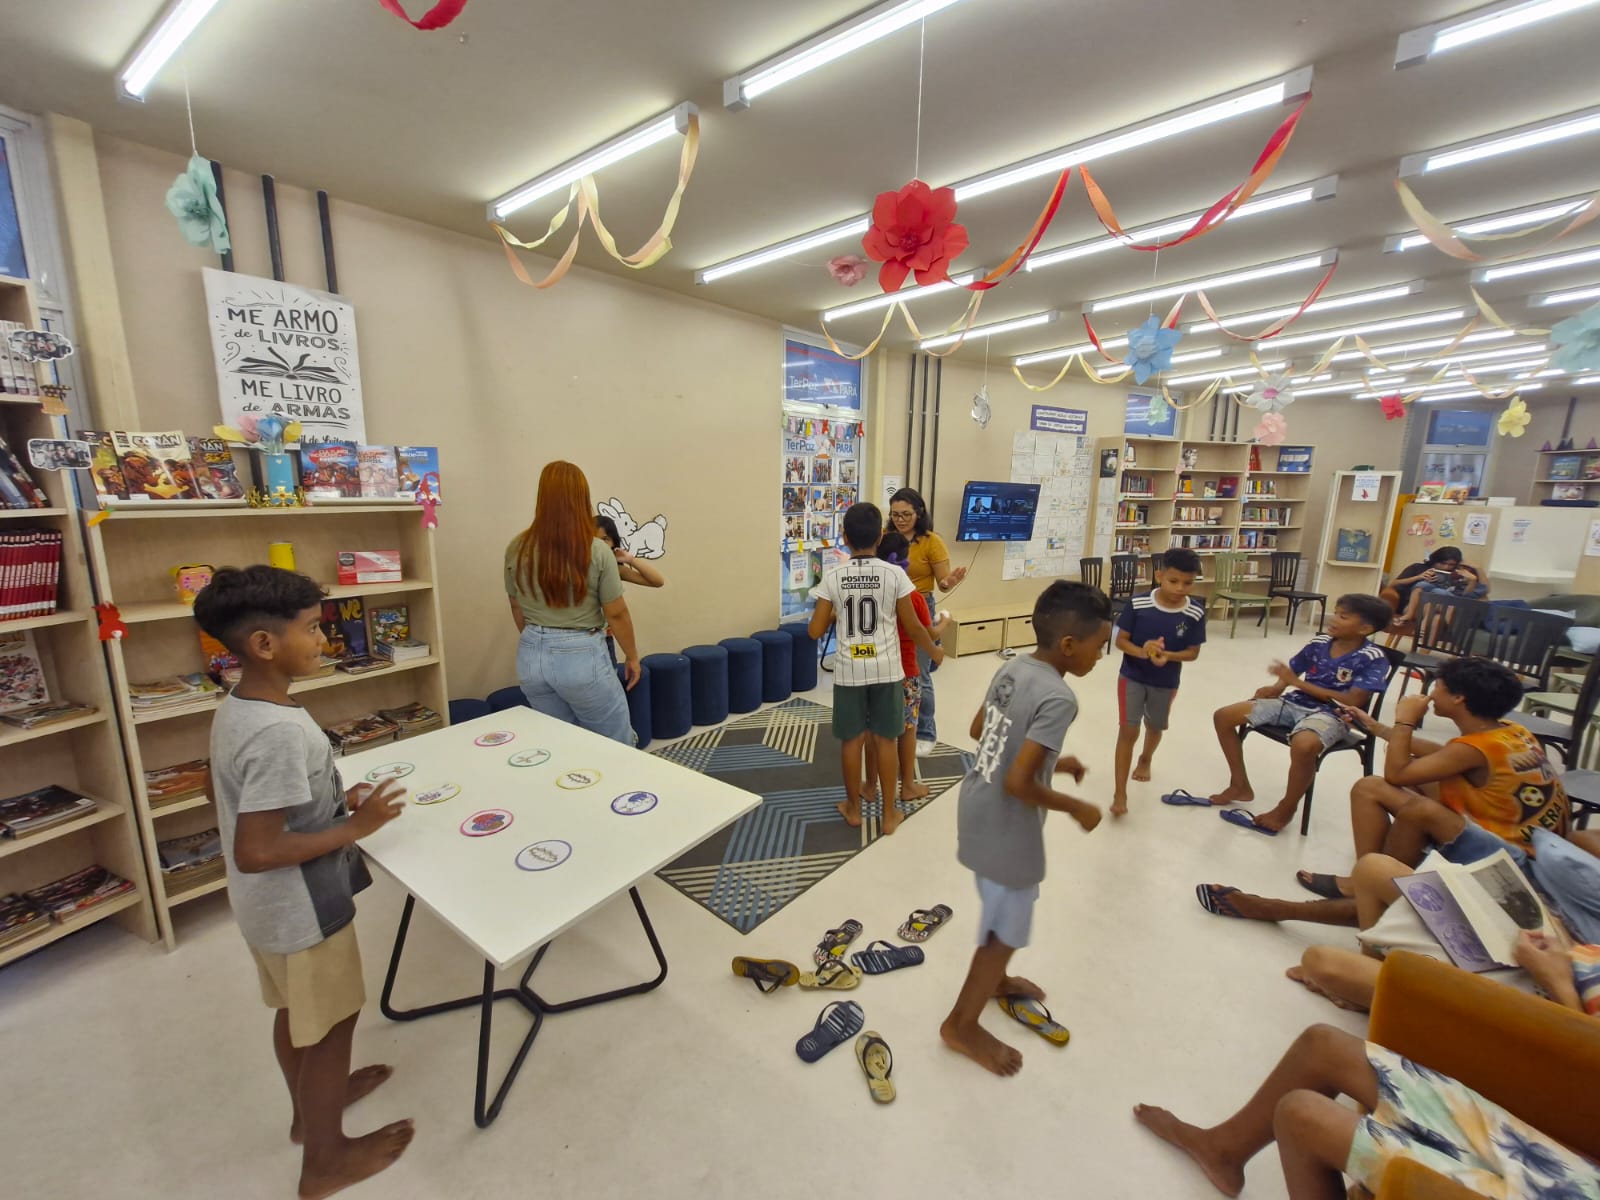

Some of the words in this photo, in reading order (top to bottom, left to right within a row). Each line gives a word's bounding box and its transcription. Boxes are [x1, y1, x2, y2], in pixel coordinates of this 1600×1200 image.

[227, 308, 265, 326] ME
[273, 309, 338, 335] ARMO
[234, 328, 252, 338] de
[258, 329, 340, 351] LIVROS
[241, 378, 273, 398] ME
[280, 382, 342, 404] LIVRO
[242, 402, 262, 412] de
[272, 402, 351, 420] ARMAS
[132, 433, 181, 449] CONAN
[841, 575, 880, 583] POSITIVO
[844, 595, 878, 637] 10
[853, 645, 875, 656] Joli
